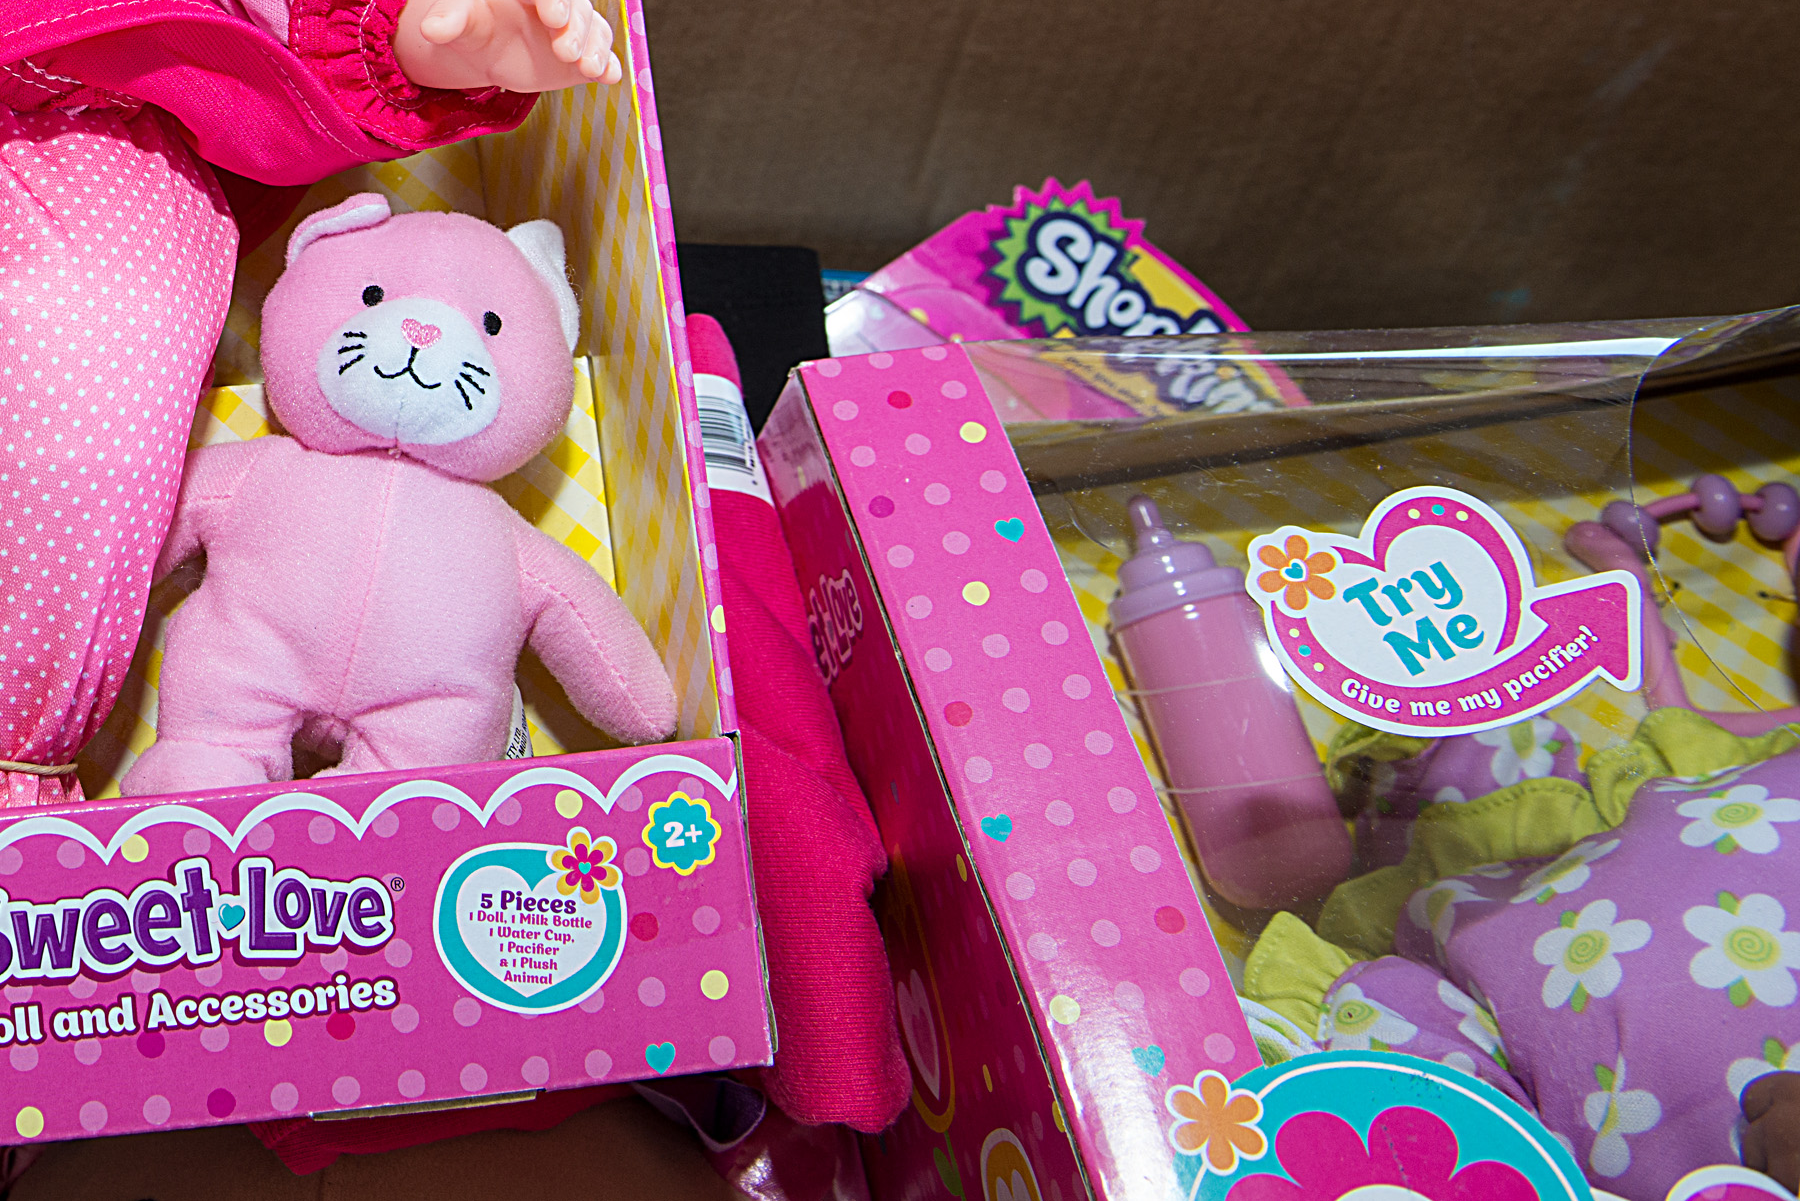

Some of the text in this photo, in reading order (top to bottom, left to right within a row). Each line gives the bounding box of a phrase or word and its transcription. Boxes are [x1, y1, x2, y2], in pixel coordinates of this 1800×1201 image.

[1342, 561, 1463, 627] Try
[1383, 613, 1485, 677] Me
[1341, 624, 1599, 717] Give me my pacifier!
[662, 820, 703, 849] 2+
[244, 864, 388, 952] Love
[480, 890, 577, 914] 5 Pieces
[477, 910, 507, 924] Doll,
[519, 912, 549, 926] Milk
[552, 914, 593, 929] Bottle
[497, 926, 541, 940] Water
[544, 928, 575, 945] Cup,
[507, 941, 560, 956] Pacifier
[499, 958, 509, 968] &
[520, 956, 558, 971] Plush
[503, 970, 553, 985] Animal
[53, 996, 137, 1039] and
[147, 974, 397, 1030] Accessories
